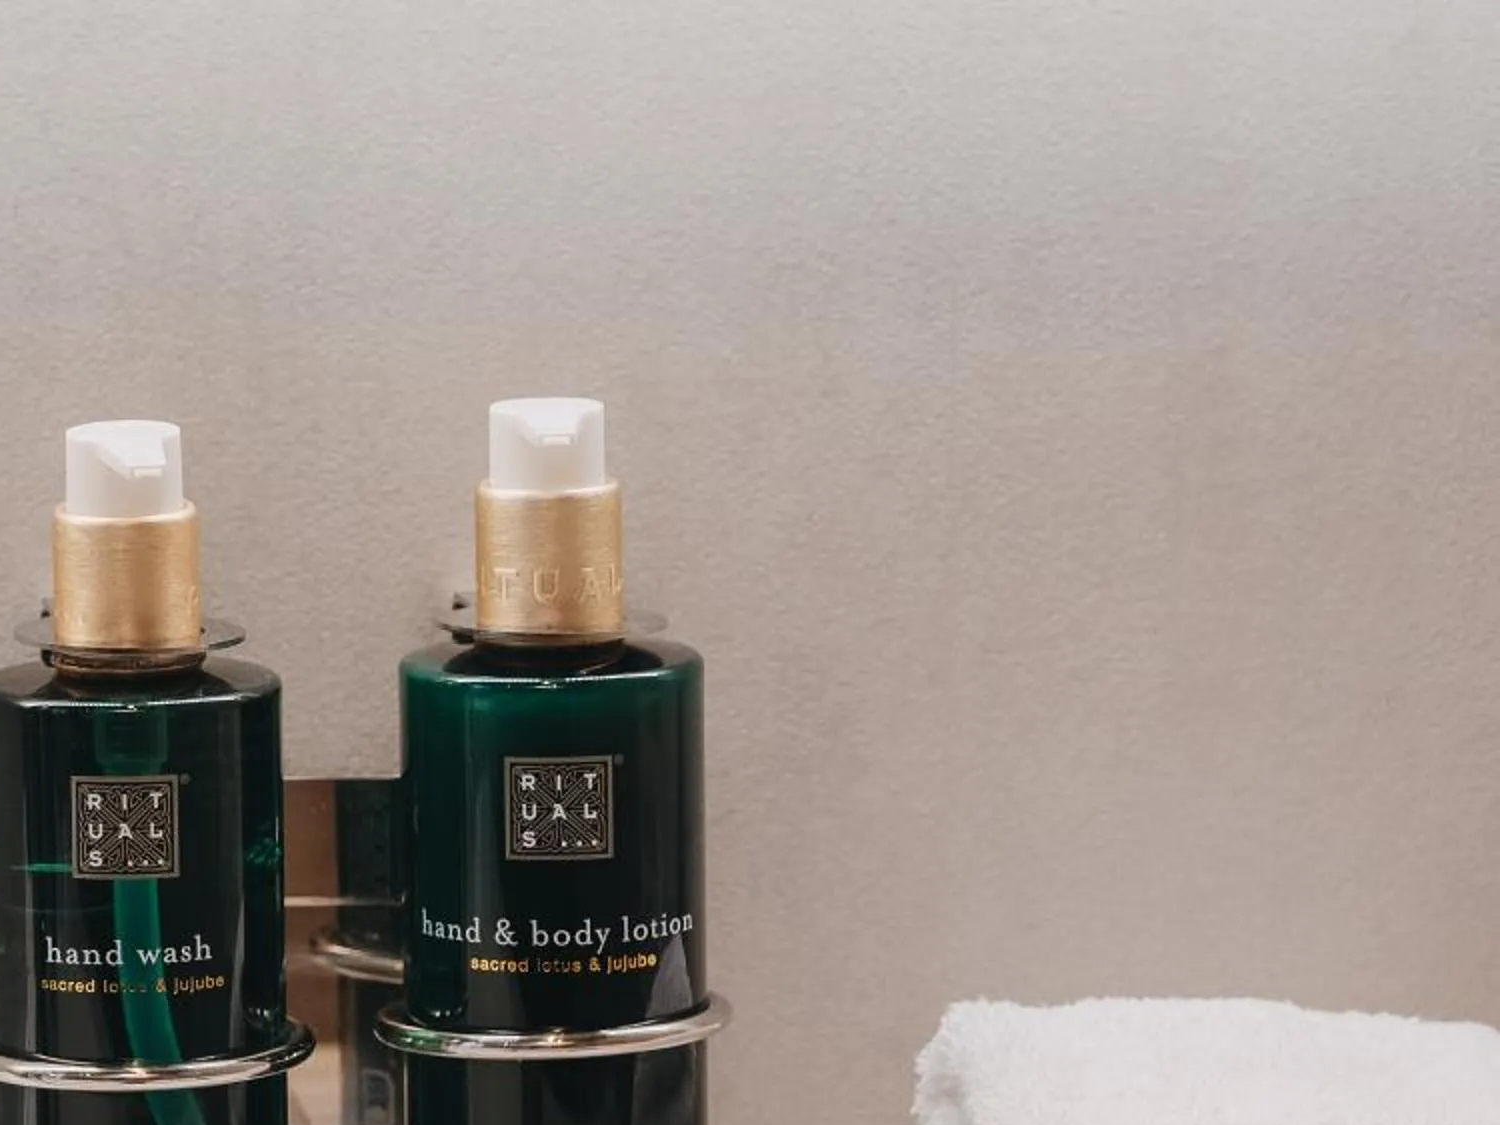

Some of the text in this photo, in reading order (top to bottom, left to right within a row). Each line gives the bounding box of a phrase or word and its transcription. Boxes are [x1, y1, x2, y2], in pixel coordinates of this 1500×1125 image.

[420, 907, 694, 954] hand & body lotion
[44, 934, 213, 966] hand wash
[470, 953, 657, 974] sacred lotus & jujube
[41, 977, 96, 993] sacred
[155, 977, 167, 993] &
[173, 974, 225, 994] jujube
